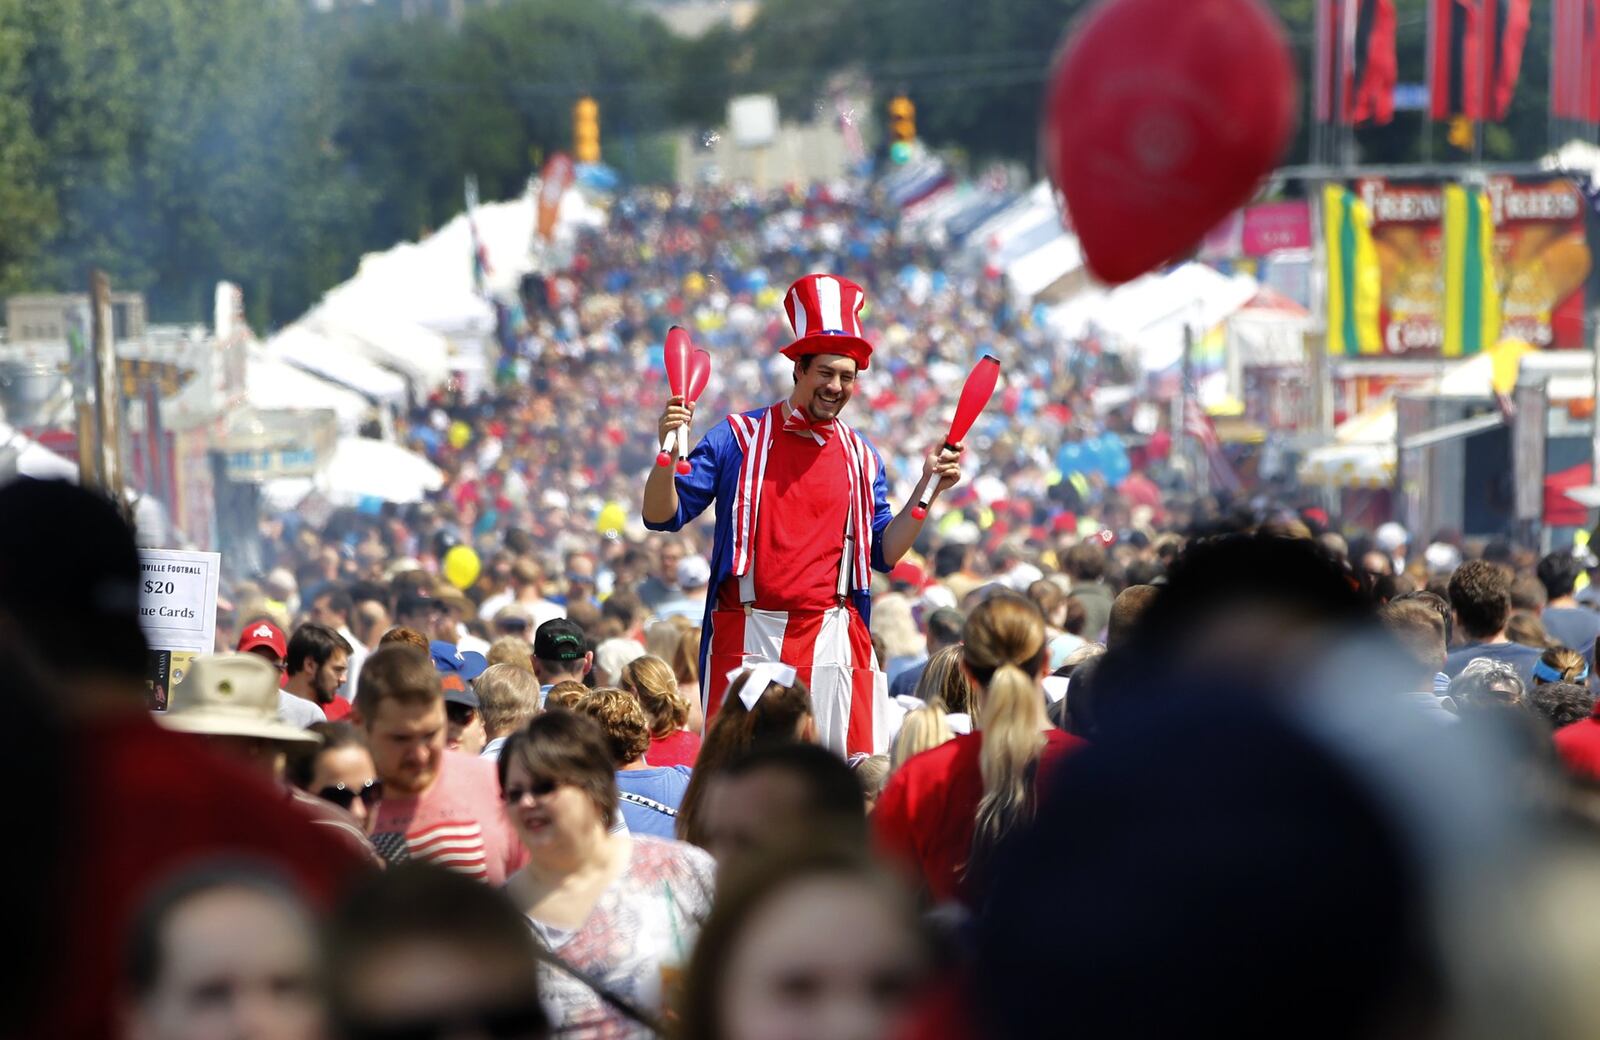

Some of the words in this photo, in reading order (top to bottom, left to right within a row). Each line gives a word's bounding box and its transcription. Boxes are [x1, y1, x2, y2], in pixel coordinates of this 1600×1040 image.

[139, 563, 165, 573] RVILLE
[167, 564, 201, 575] FOOTBALL
[144, 580, 175, 595] $20
[139, 606, 156, 616] ue
[159, 606, 195, 618] Cards
